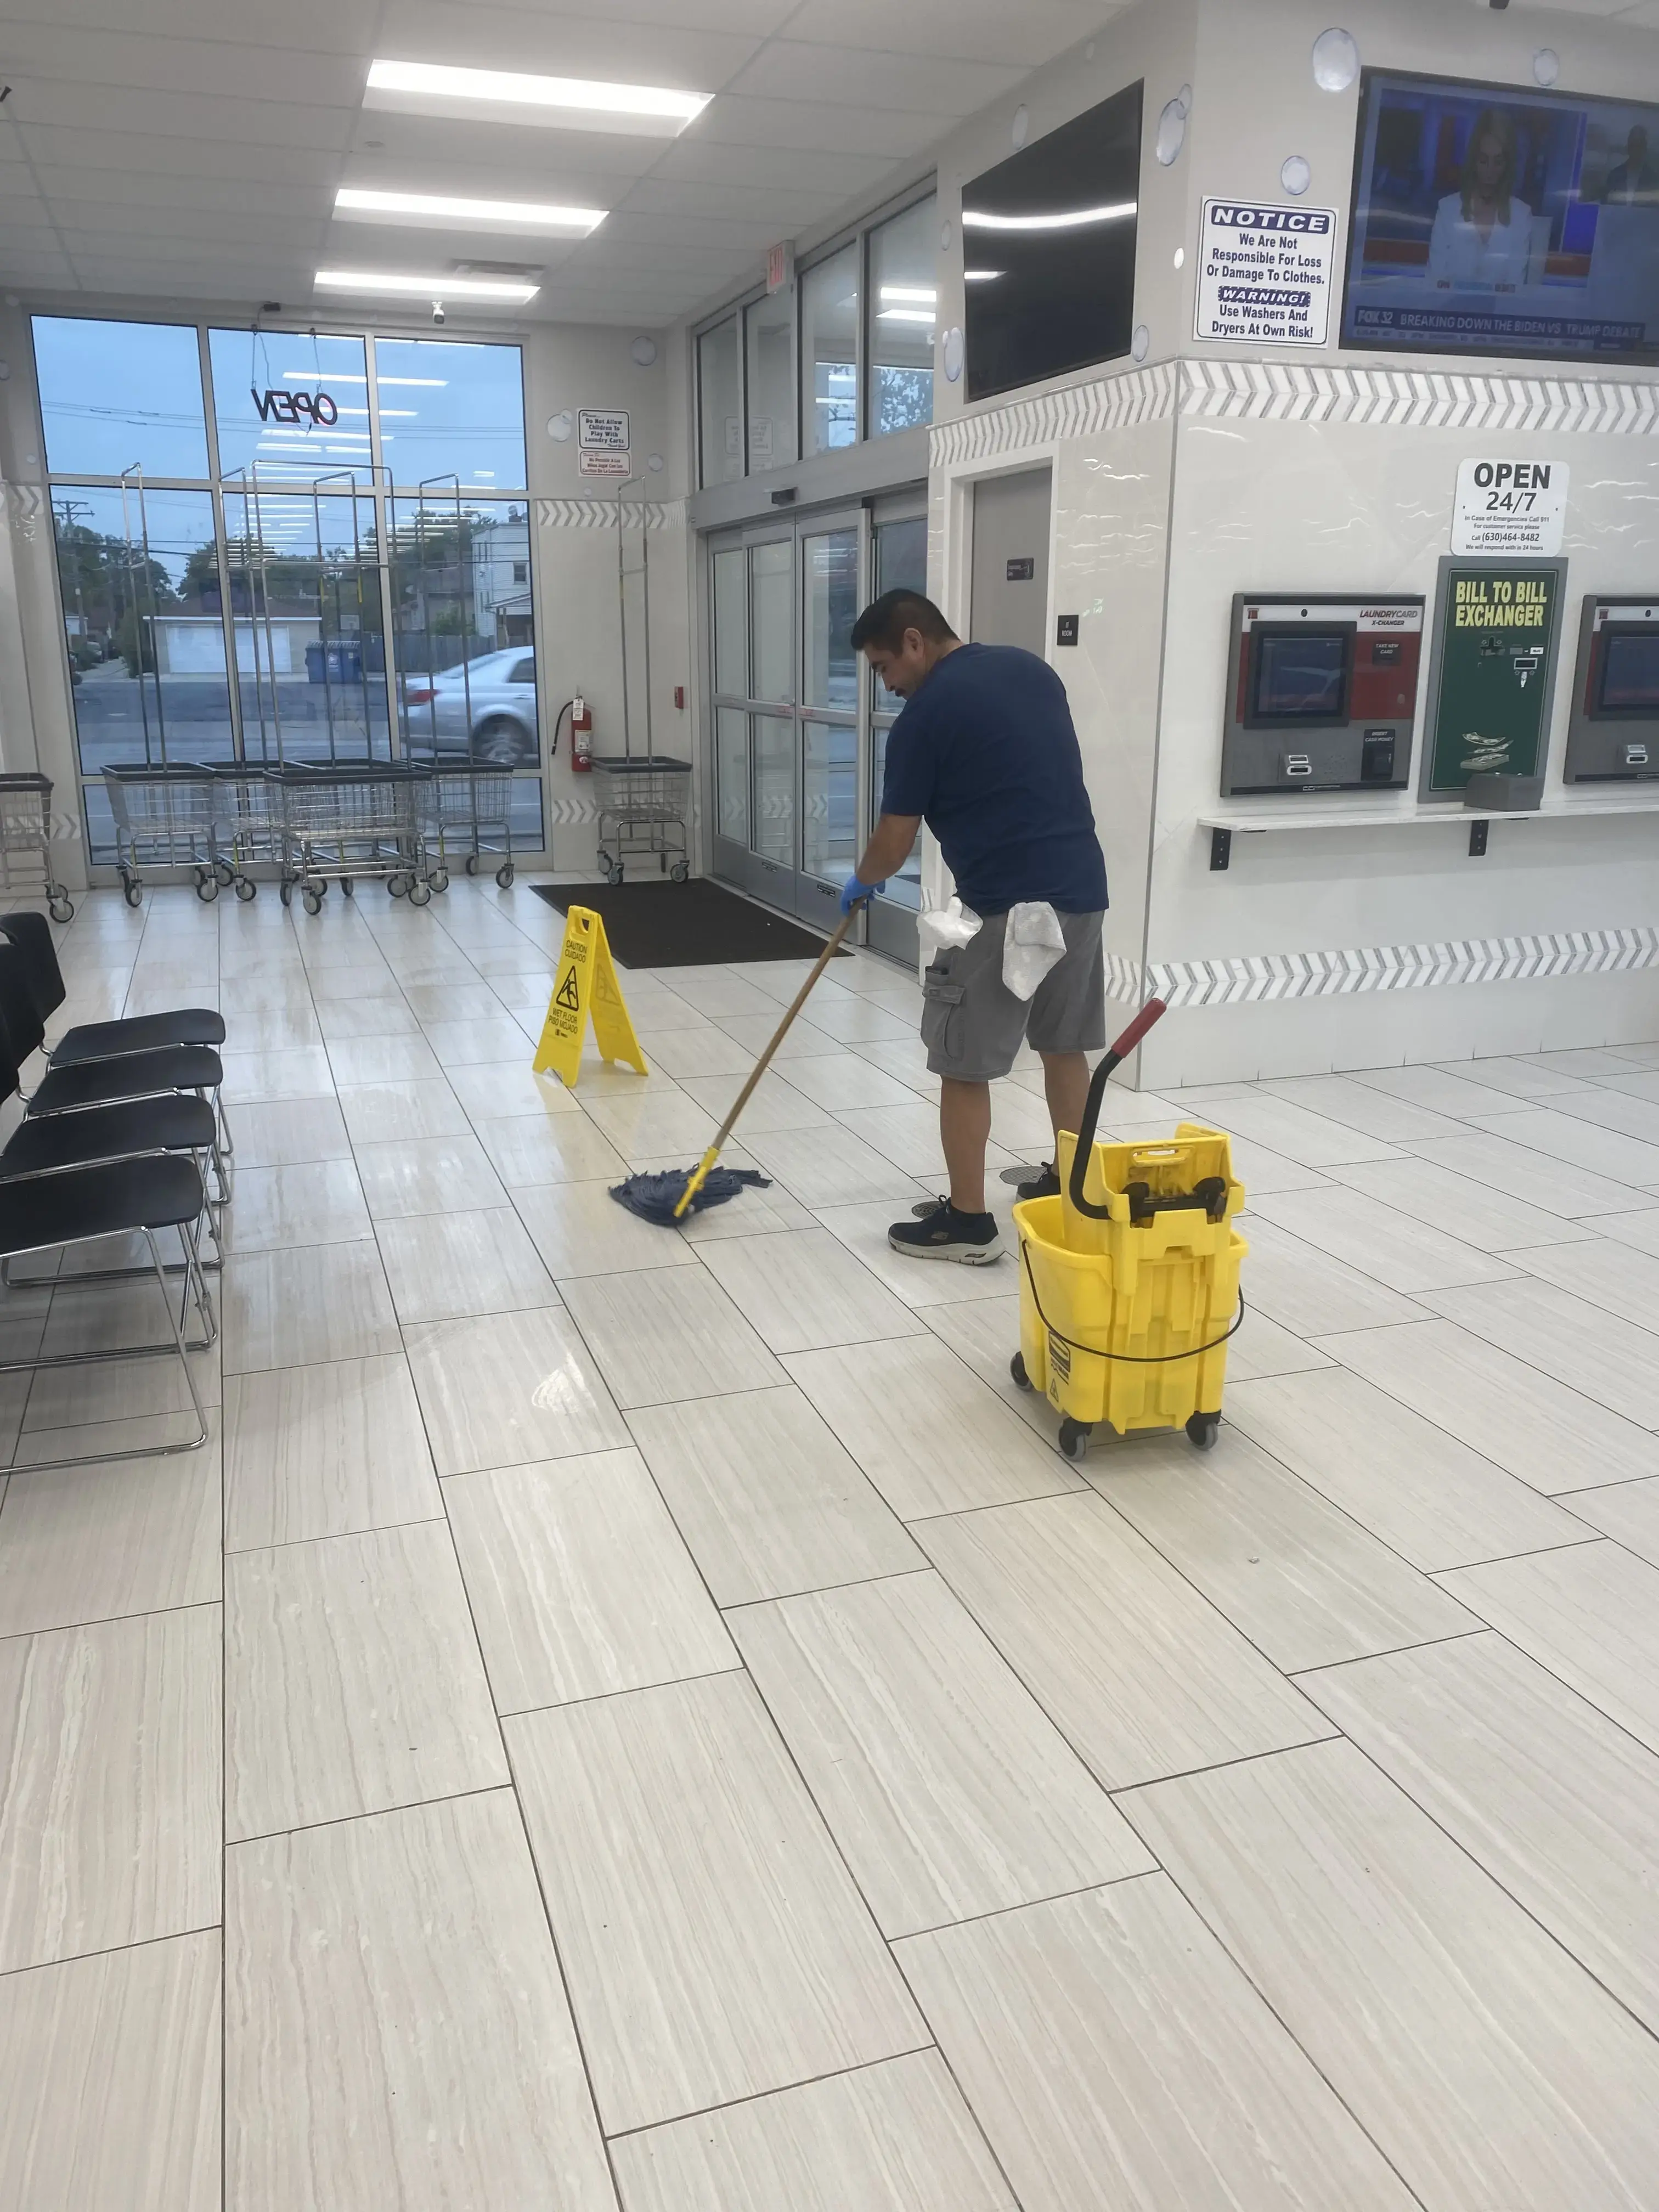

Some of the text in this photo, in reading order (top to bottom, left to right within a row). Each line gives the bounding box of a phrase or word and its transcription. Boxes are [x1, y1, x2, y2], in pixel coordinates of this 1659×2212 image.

[1214, 209, 1325, 232] NOTICE
[1239, 233, 1297, 249] We Are Not
[1212, 248, 1322, 267] Responsible For Loss
[1207, 264, 1324, 284] Or Damage To Clothes.
[1222, 290, 1305, 303] WARNING!
[1220, 304, 1307, 321] Use Washers And
[1358, 310, 1393, 324] FOX 32
[1212, 321, 1313, 338] Dryers At Own Risk!
[1401, 314, 1641, 338] BREAKING DOWN THE BIDEN VS TRUMP DEBATE
[1474, 462, 1551, 489] OPEN
[1486, 492, 1537, 514] 24/7
[1482, 533, 1539, 543] (630)464-8482
[1456, 581, 1547, 603] BILL TO BILL
[1455, 605, 1544, 627] EXCHANGER
[566, 940, 587, 953] CAUTION
[565, 949, 586, 963] CUIDADO
[549, 1015, 558, 1027] PISO
[560, 1019, 578, 1034] MOJADO
[553, 1007, 577, 1024] WET FLOOR
